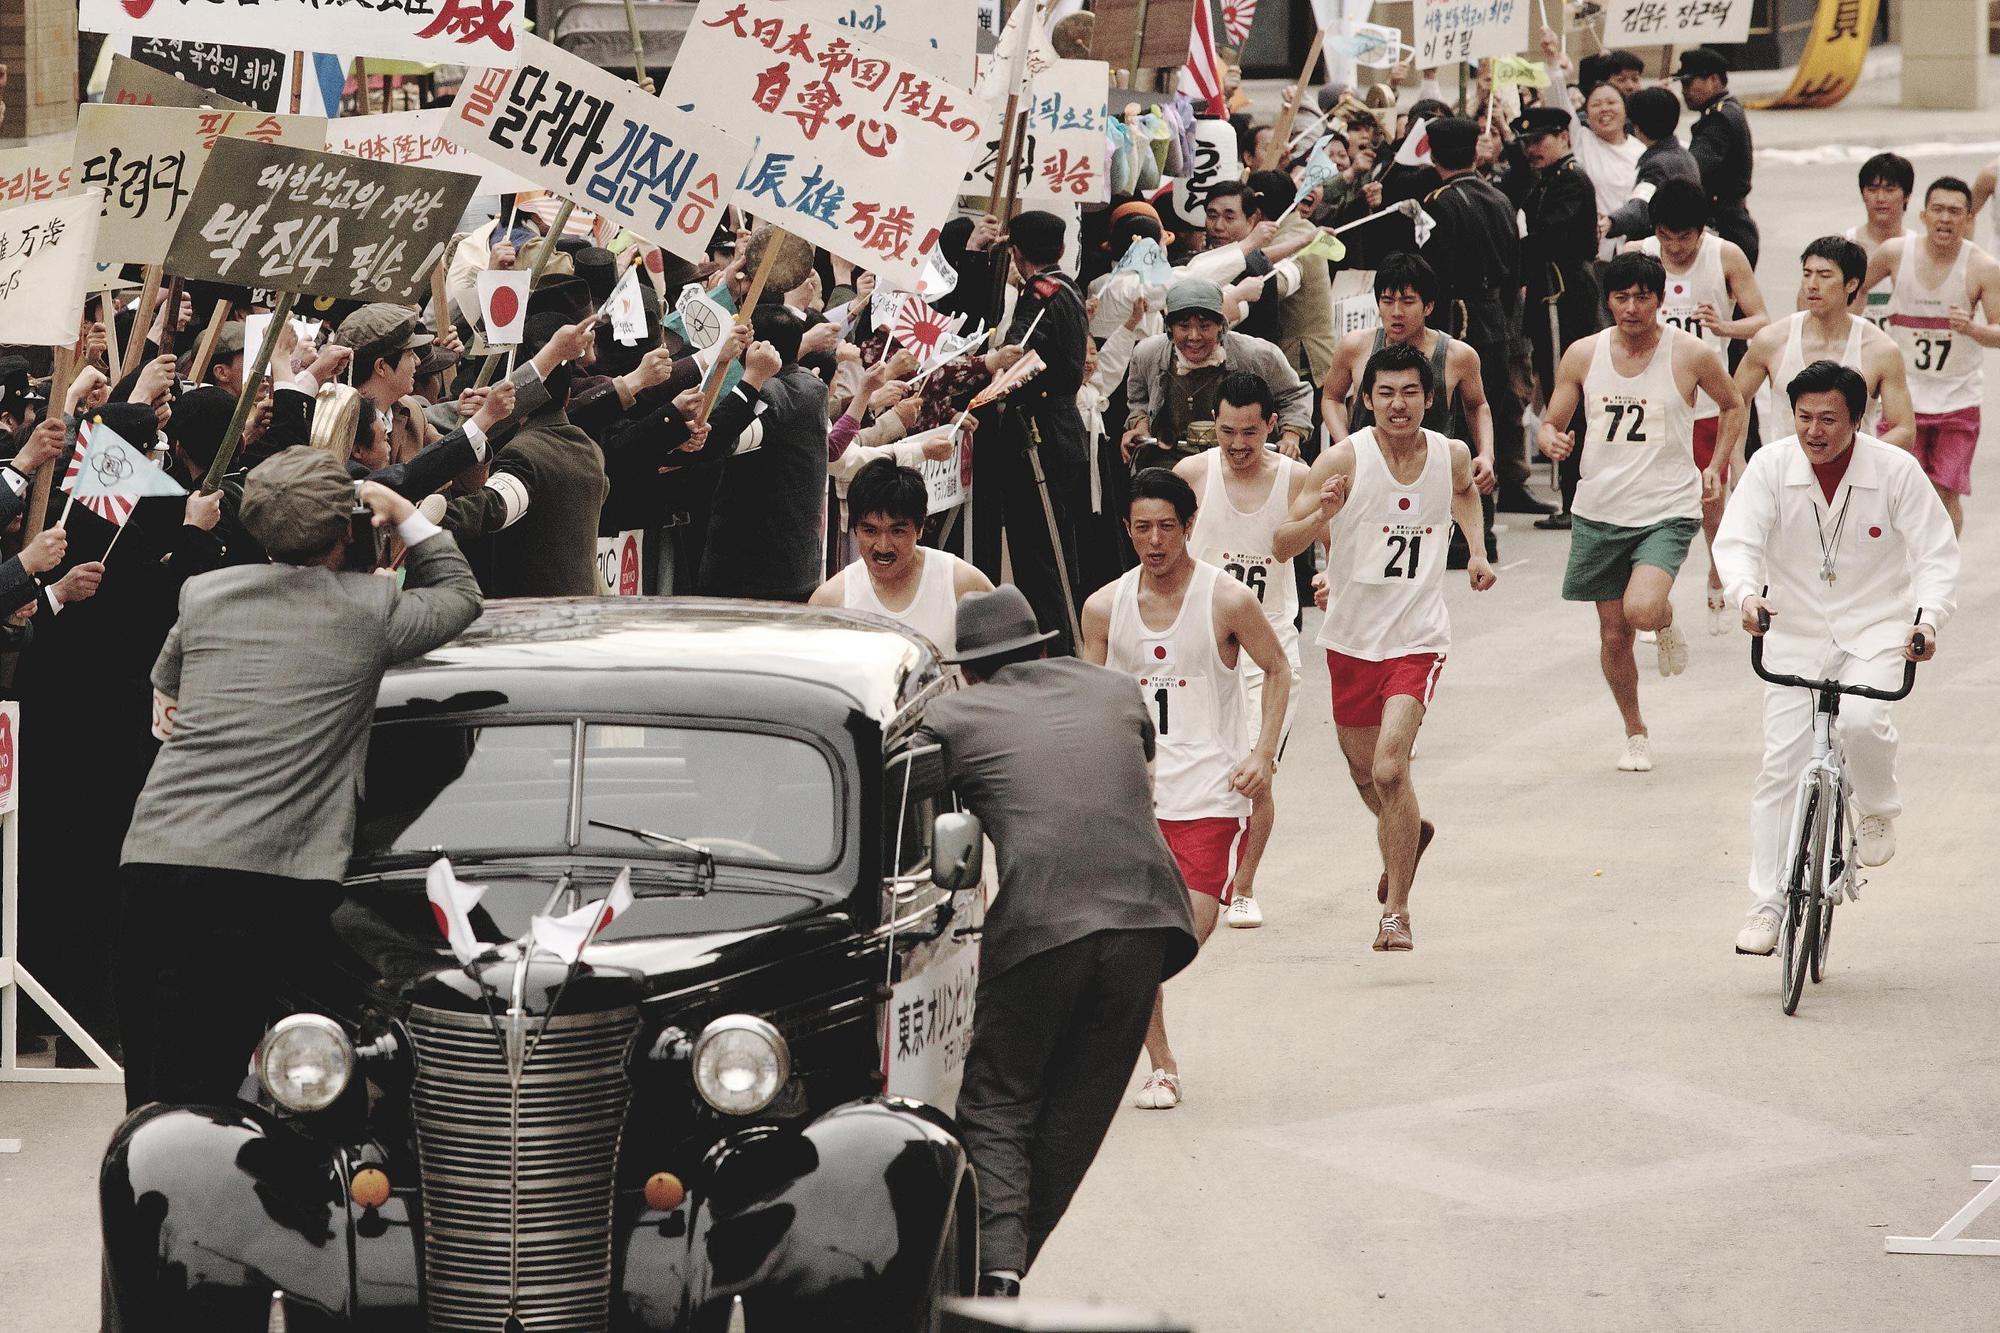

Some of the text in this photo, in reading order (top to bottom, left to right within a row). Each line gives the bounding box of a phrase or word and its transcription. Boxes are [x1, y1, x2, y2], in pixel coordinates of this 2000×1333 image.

[188, 41, 239, 79] 육상의
[241, 57, 278, 92] 희망
[488, 65, 616, 185] 달려라
[586, 119, 699, 231] 김준식
[676, 171, 720, 235] 승
[1040, 148, 1095, 195] 필승
[380, 186, 445, 231] 자랑
[349, 234, 446, 296] 필승!
[1915, 338, 1952, 371] 37
[1605, 404, 1646, 442] 72
[1384, 535, 1422, 579] 21
[1154, 688, 1168, 735] 1
